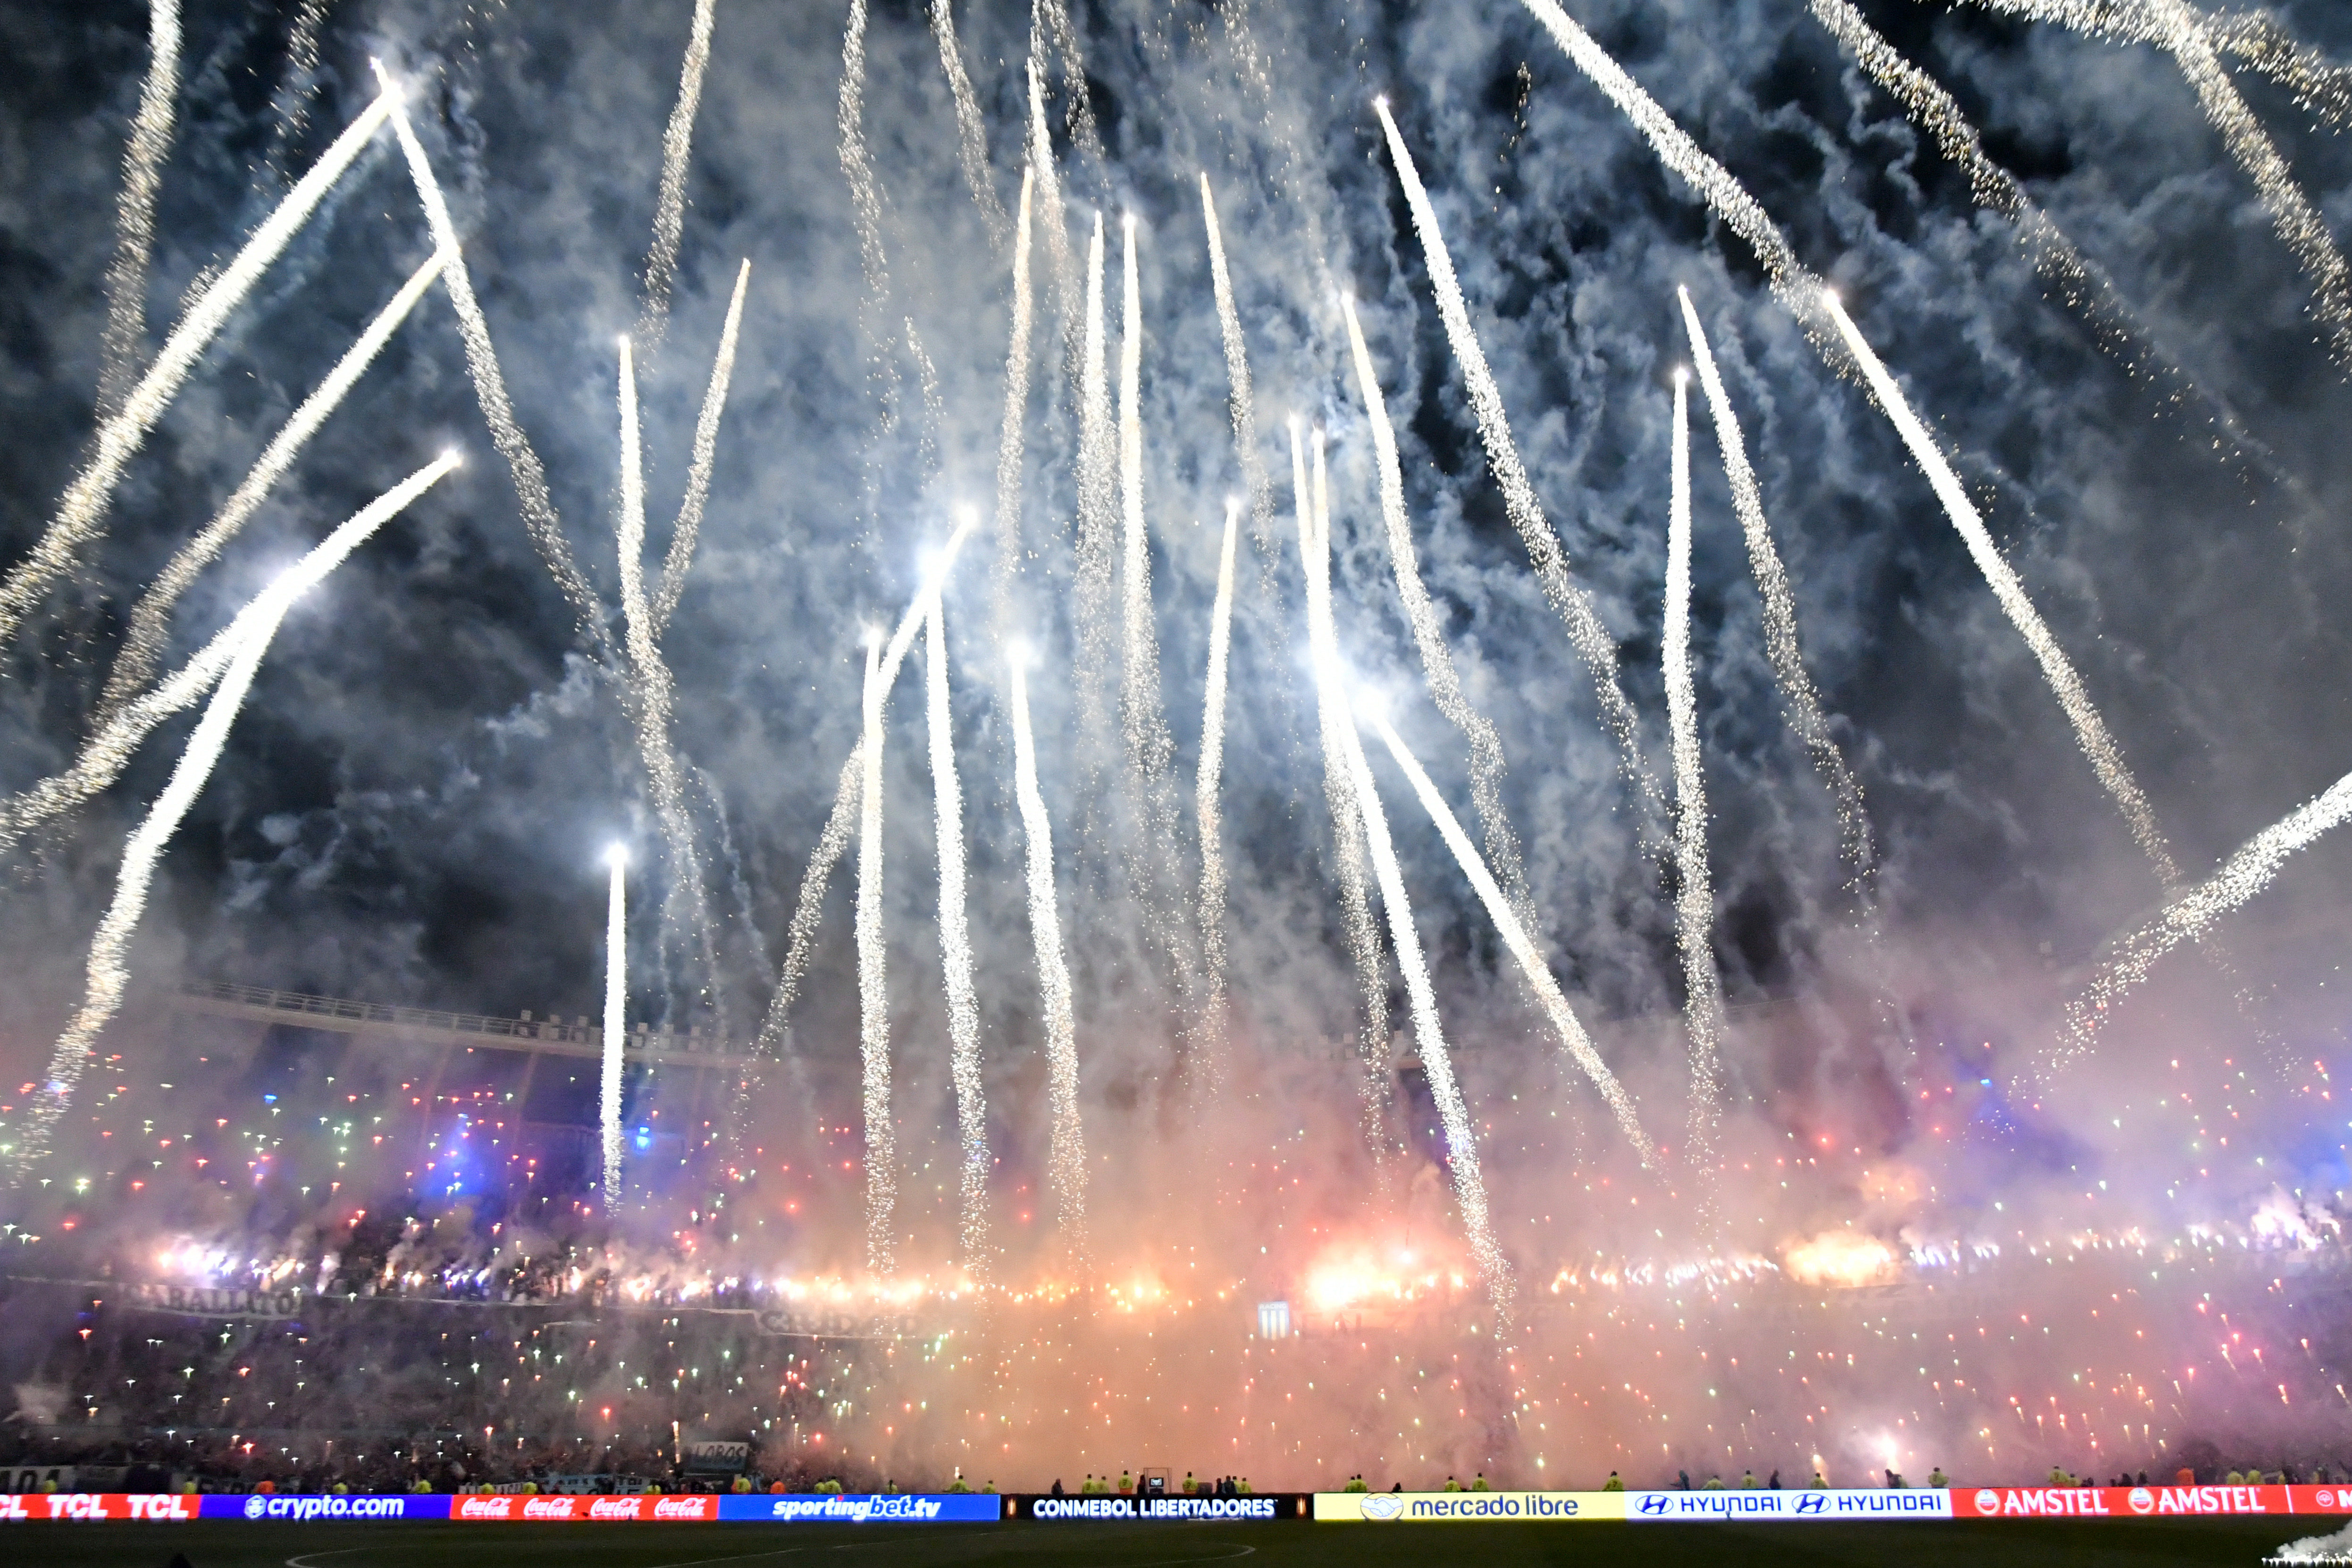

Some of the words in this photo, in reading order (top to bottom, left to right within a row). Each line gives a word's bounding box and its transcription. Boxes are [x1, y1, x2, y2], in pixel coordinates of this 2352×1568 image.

[47, 1494, 108, 1517] TCL
[127, 1494, 188, 1517] TCL
[268, 1495, 404, 1518] crypto.com
[461, 1497, 513, 1516] Coca-Cola
[524, 1498, 575, 1516] Coca-Cola
[590, 1498, 643, 1516] Coca-Cola
[654, 1497, 707, 1516] Coca-Cola
[773, 1495, 941, 1520] sportingbet.tv
[1033, 1499, 1137, 1516] CONMEBOL
[1140, 1499, 1275, 1516] LIBERTADORES
[1412, 1494, 1520, 1516] mercado
[1525, 1494, 1578, 1516] libre
[1680, 1496, 1781, 1512] HYUNDAI
[1838, 1495, 1941, 1510] HYUNDAI
[2004, 1489, 2109, 1513] AMSTEL
[2159, 1487, 2265, 1512] AMSTEL
